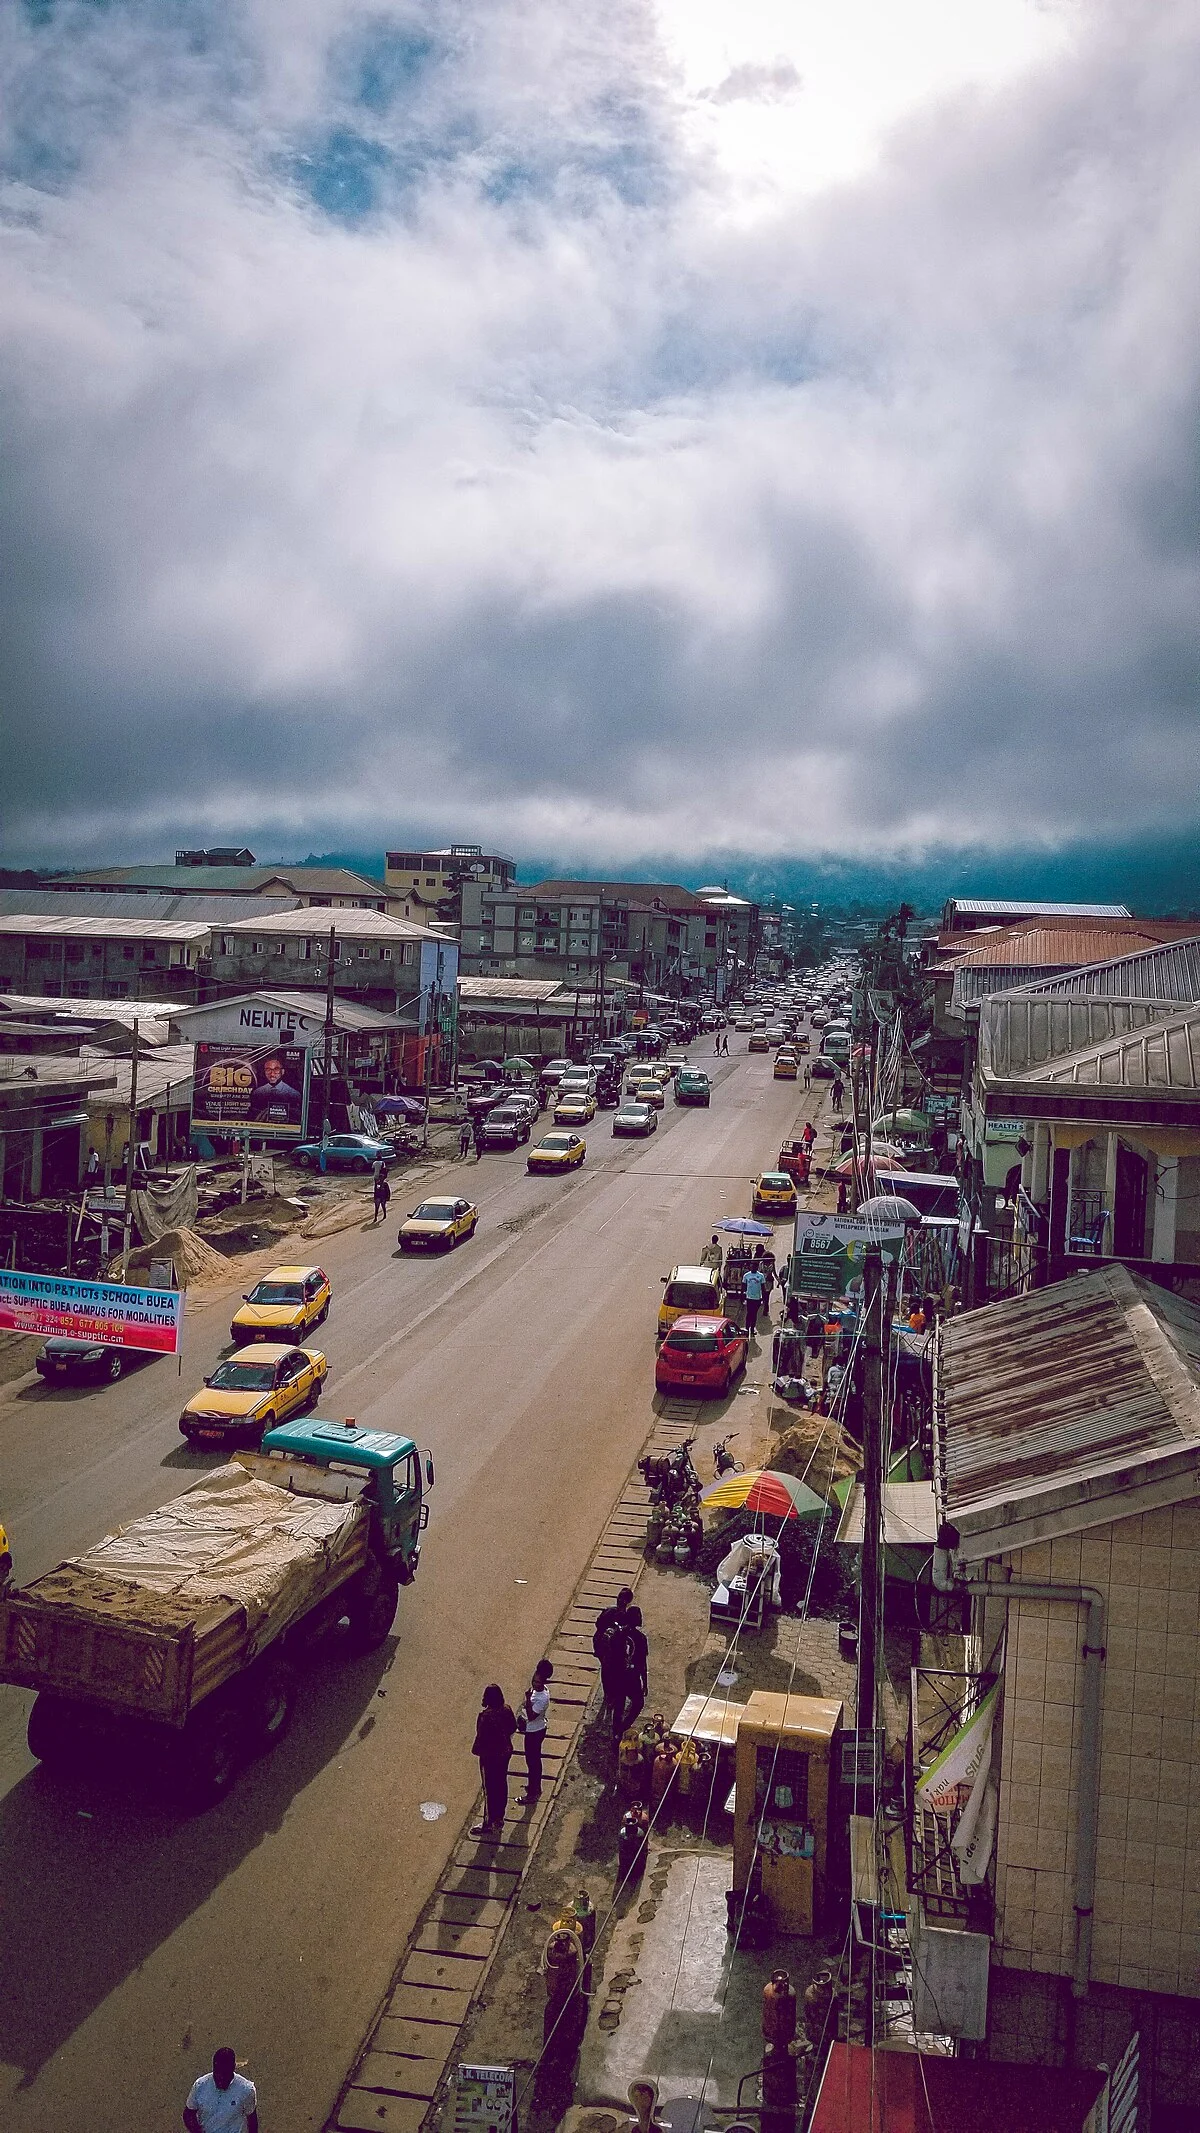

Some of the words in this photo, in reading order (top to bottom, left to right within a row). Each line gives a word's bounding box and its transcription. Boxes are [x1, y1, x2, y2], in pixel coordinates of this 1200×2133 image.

[239, 1009, 309, 1031] NEWTEC
[210, 1067, 252, 1087] BIG
[988, 1121, 1017, 1130] HEALTH
[835, 1223, 866, 1231] DEVELOPMENT
[810, 1239, 831, 1250] 8567
[28, 1280, 52, 1294] INTO
[55, 1284, 99, 1300] P&T-ICTs
[102, 1290, 143, 1305] SCHOOL
[147, 1296, 175, 1310] BUEA
[50, 1302, 71, 1313] BUEA
[73, 1305, 106, 1317] CAMPUS
[108, 1308, 124, 1320] FOR
[126, 1309, 175, 1327] MODALITIES
[60, 1316, 74, 1325] 852
[79, 1319, 93, 1329] 677
[94, 1321, 109, 1331] 805
[476, 2070, 513, 2082] TELECOM
